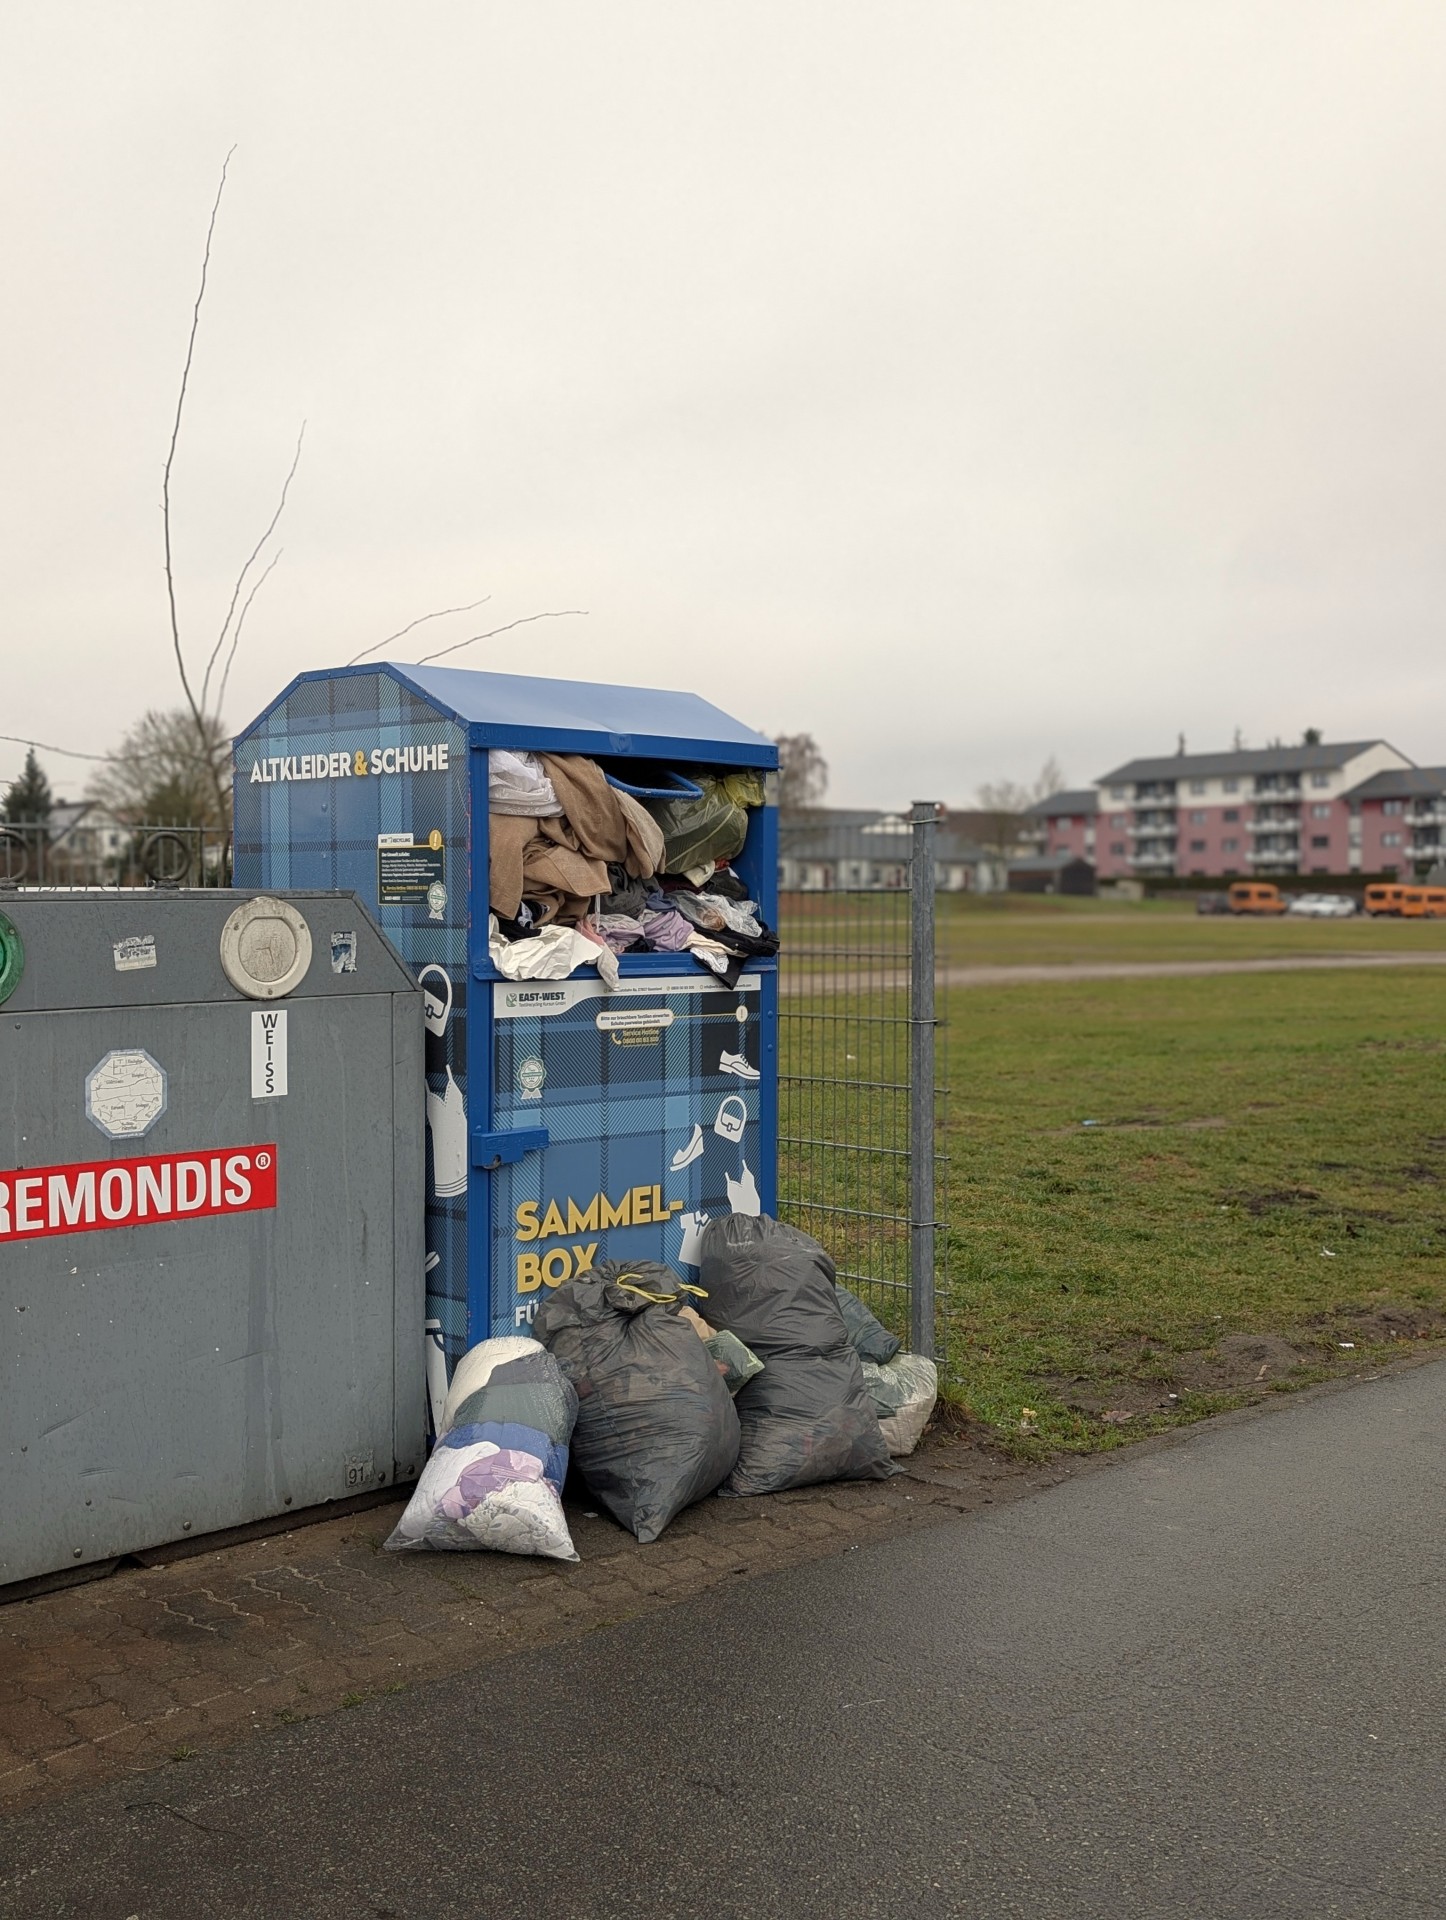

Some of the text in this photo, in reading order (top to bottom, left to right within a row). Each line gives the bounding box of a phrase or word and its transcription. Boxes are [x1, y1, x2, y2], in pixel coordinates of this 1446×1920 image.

[250, 744, 449, 784] ALTKLEIDER & SCHUHE
[261, 1013, 278, 1094] WEISS
[515, 1184, 684, 1242] SAMMEL-
[517, 1242, 598, 1293] BOX
[516, 1299, 542, 1327] FÜ
